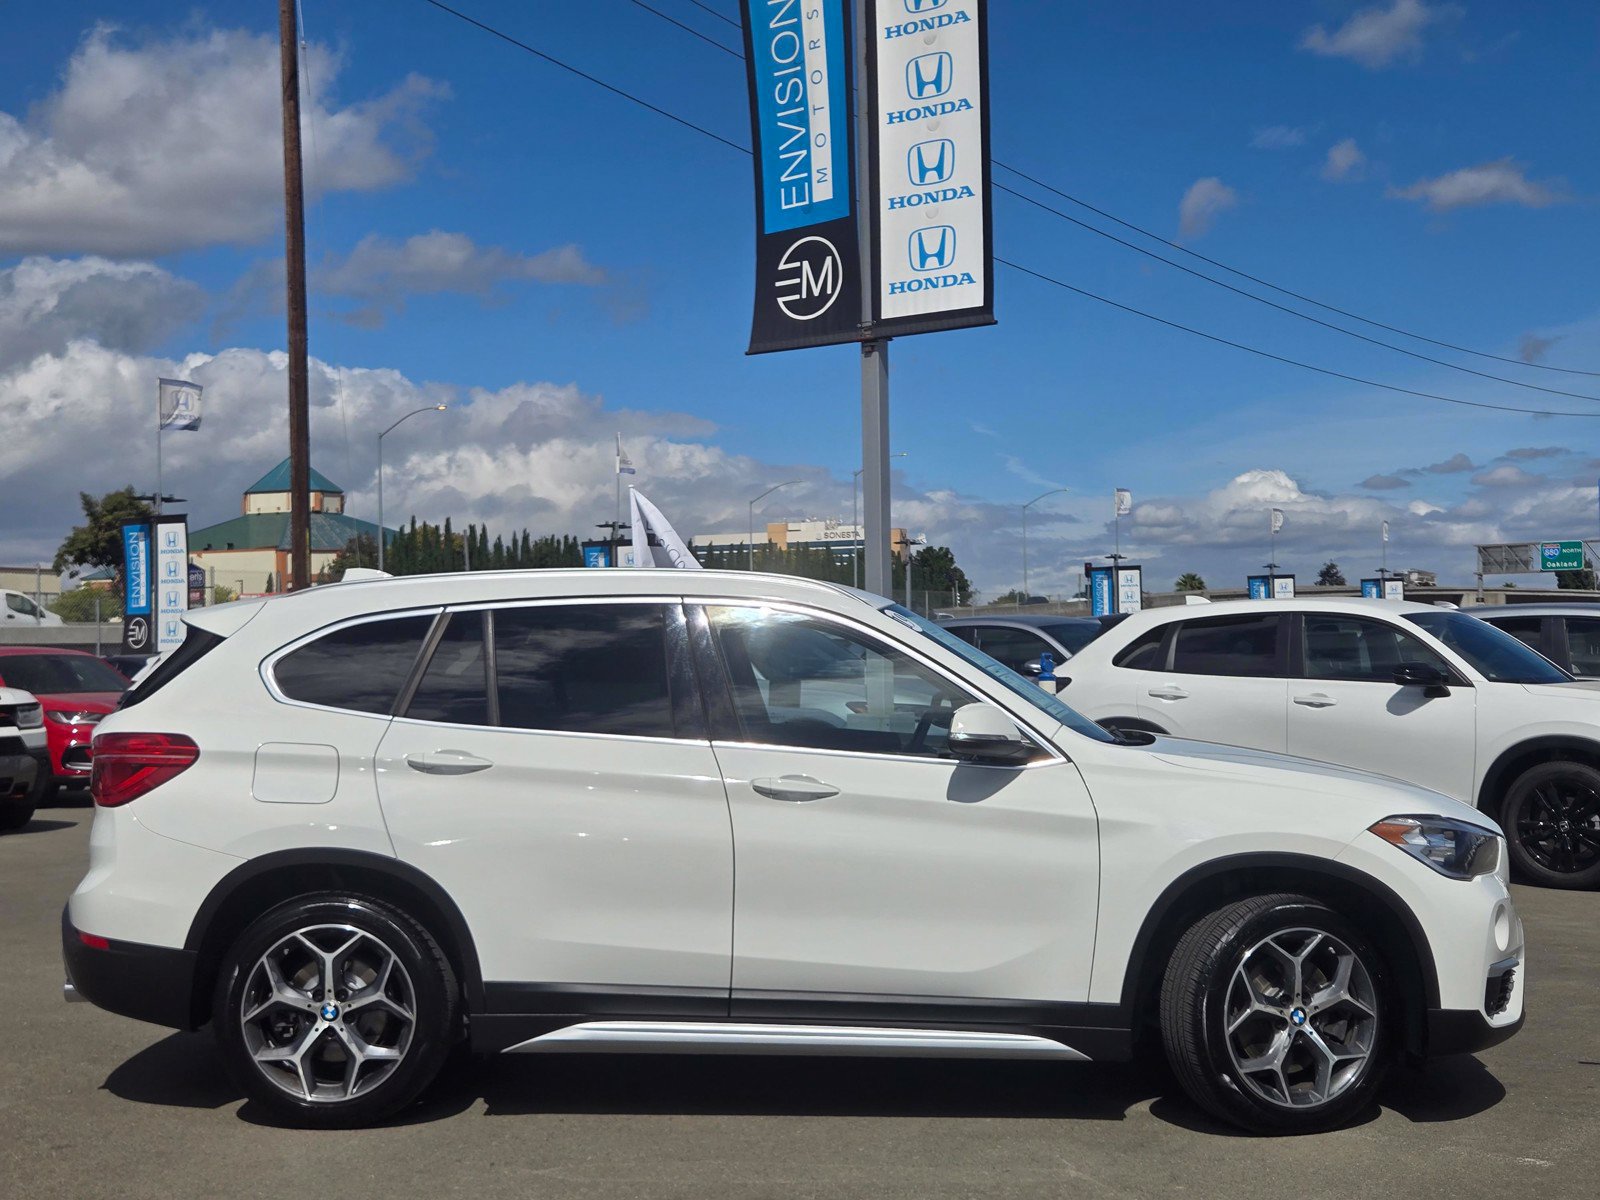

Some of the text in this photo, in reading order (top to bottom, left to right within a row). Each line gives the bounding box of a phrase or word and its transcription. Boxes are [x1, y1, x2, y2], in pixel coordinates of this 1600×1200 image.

[884, 10, 971, 39] HONDA
[768, 0, 809, 210] ENVISION
[806, 8, 829, 184] MOTORS
[886, 97, 974, 125] HONDA
[887, 185, 975, 210] HONDA
[888, 272, 977, 295] HONDA
[823, 530, 861, 539] SONESTA
[1544, 548, 1559, 556] 880
[128, 532, 141, 608] ENVISION
